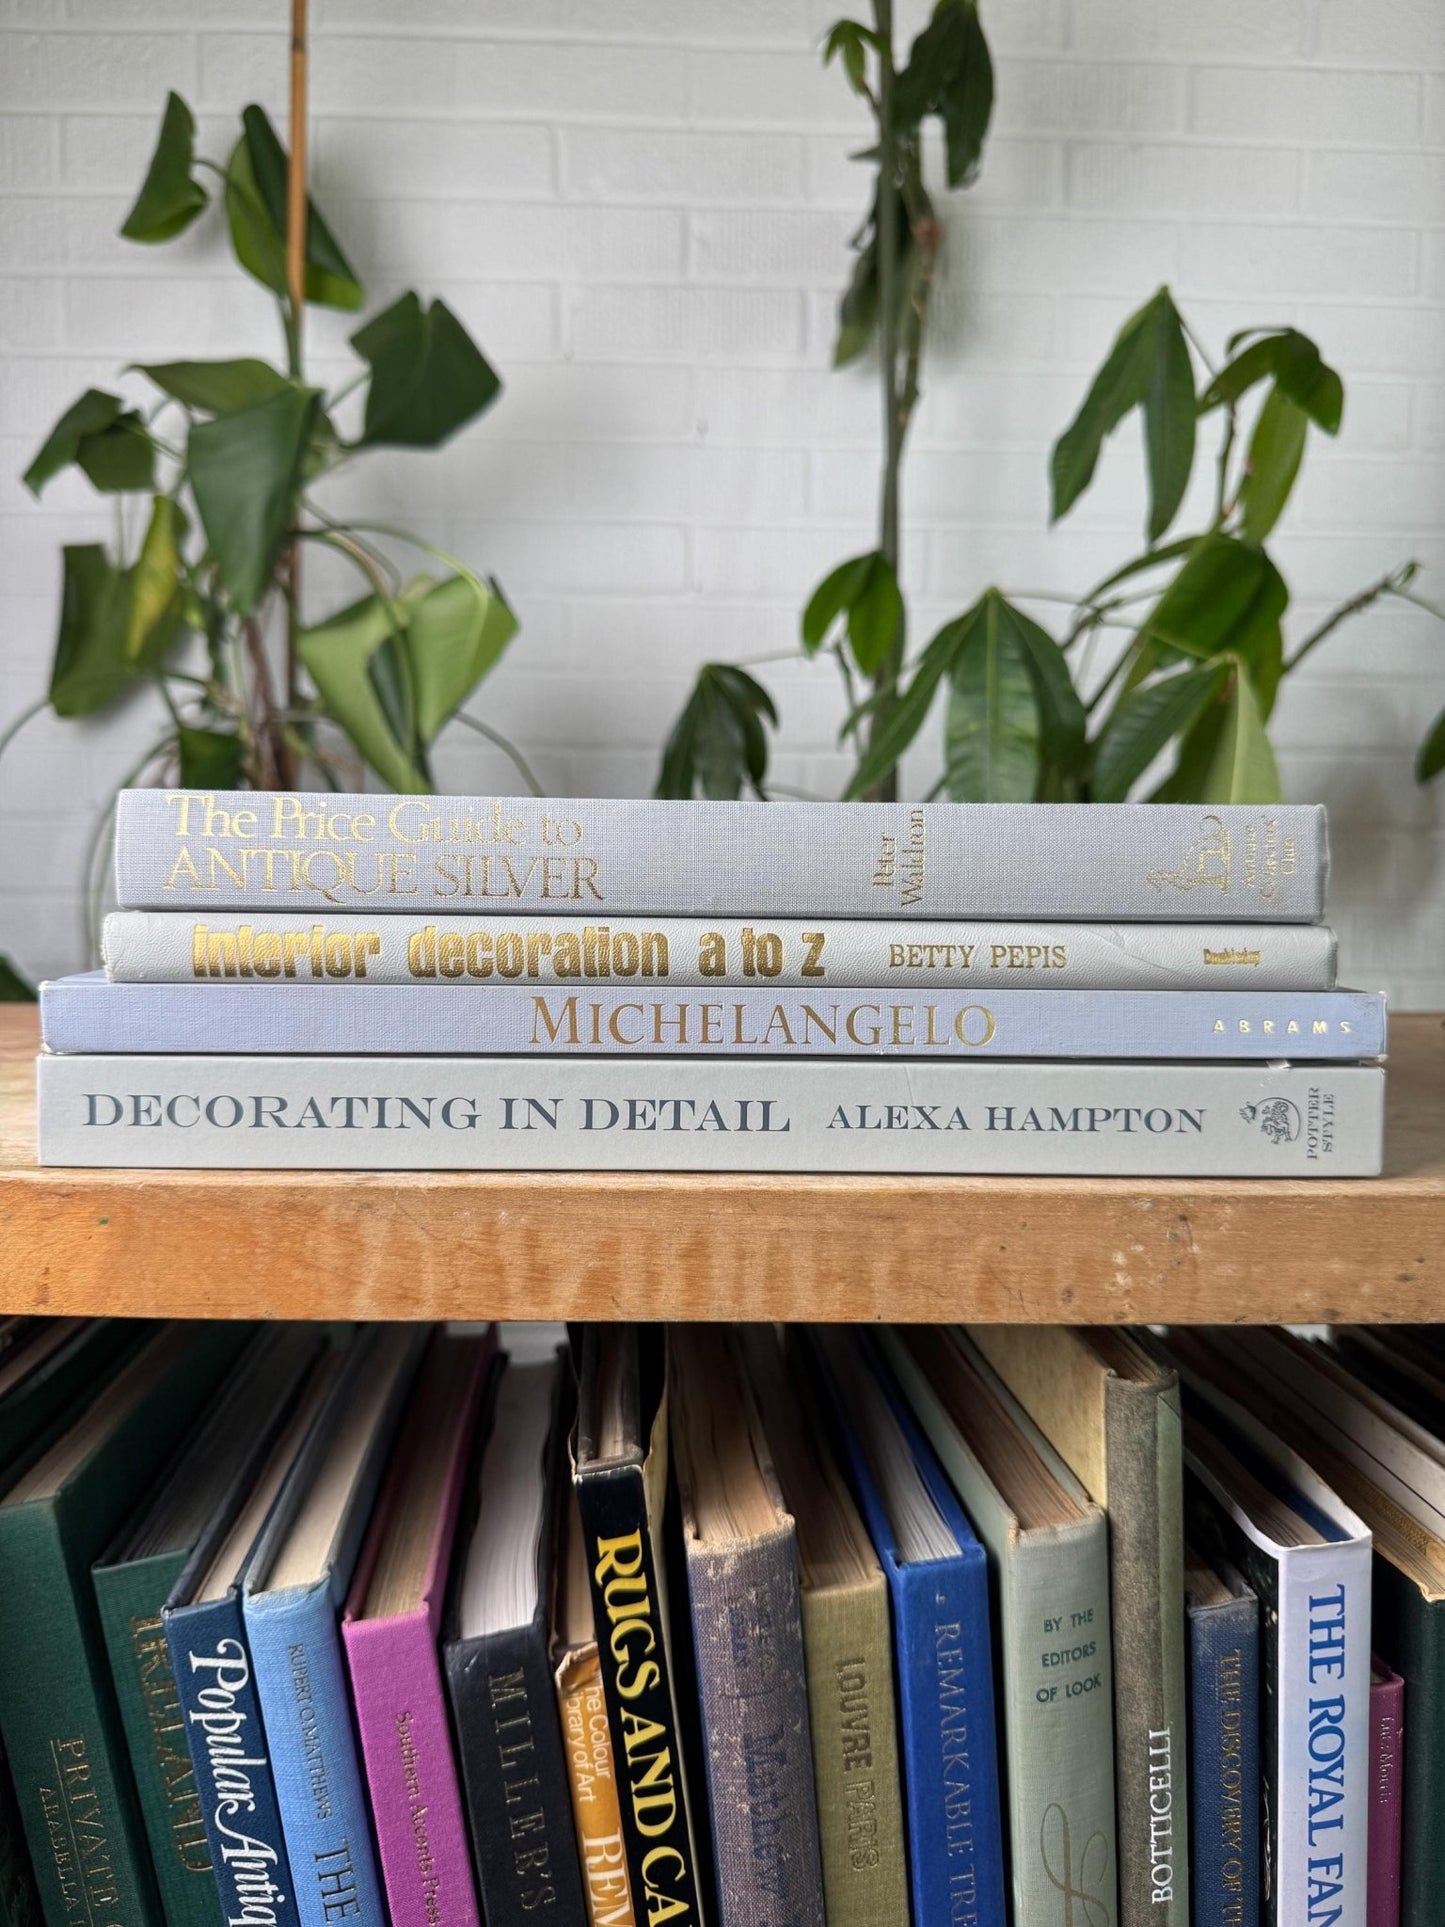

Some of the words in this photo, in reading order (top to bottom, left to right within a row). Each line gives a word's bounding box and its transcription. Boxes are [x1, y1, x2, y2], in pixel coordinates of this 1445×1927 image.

[166, 793, 257, 838] The
[272, 797, 376, 842] Price
[387, 800, 528, 847] Guide
[541, 813, 584, 847] to
[163, 845, 418, 906] ANTIQUE
[433, 853, 606, 900] SILVER
[872, 832, 896, 887] Peter
[900, 809, 925, 908] Waldron
[192, 923, 382, 979] interior
[407, 924, 670, 978] decoration
[699, 931, 727, 978] a
[741, 927, 784, 977] to
[801, 932, 826, 977] z
[889, 944, 976, 969] BETTY
[990, 945, 1068, 969] PEPIS
[529, 995, 998, 1048] MICHELANGELO
[1213, 1019, 1353, 1035] ABRAMS
[87, 1093, 483, 1131] DECORATING
[500, 1097, 563, 1131] IN
[579, 1098, 791, 1132] DETAIL
[826, 1104, 972, 1131] ALEXA
[984, 1105, 1208, 1134] HAMPTON
[1307, 1087, 1319, 1160] POTTER
[1322, 1094, 1334, 1153] STYLE
[595, 1526, 661, 1701] RUGS
[1044, 1617, 1063, 1633] BY
[1070, 1608, 1094, 1628] THE
[1308, 1583, 1346, 1685] THE
[288, 1643, 314, 1705] RUPERT
[1041, 1641, 1098, 1668] EDITORS
[1221, 1648, 1242, 1704] THE
[586, 1685, 603, 1712] he
[835, 1656, 873, 1774] LOUVRE
[1036, 1687, 1058, 1704] OF
[1066, 1673, 1102, 1699] LOOK
[189, 1638, 268, 1813] Popular
[566, 1692, 586, 1748] ibrary
[588, 1714, 612, 1779] Colour
[935, 1620, 975, 1857] REMARKABLE
[396, 1709, 422, 1800] Southern
[572, 1750, 589, 1771] of
[620, 1706, 677, 1838] AND
[1221, 1710, 1242, 1852] DISCOVERY
[1308, 1694, 1347, 1847] ROYAL
[487, 1666, 557, 1911] MILLER'S
[575, 1771, 595, 1803] Art
[1149, 1726, 1174, 1905] BOTTICELLI
[40, 1786, 80, 1911] ARABELLA
[58, 1733, 119, 1908] PRIVATE
[410, 1803, 435, 1874] Accents
[846, 1779, 880, 1872] PARIS
[314, 1836, 361, 1923] THE
[422, 1876, 442, 1927] Press
[641, 1845, 696, 1927] CA
[1221, 1856, 1243, 1892] OF
